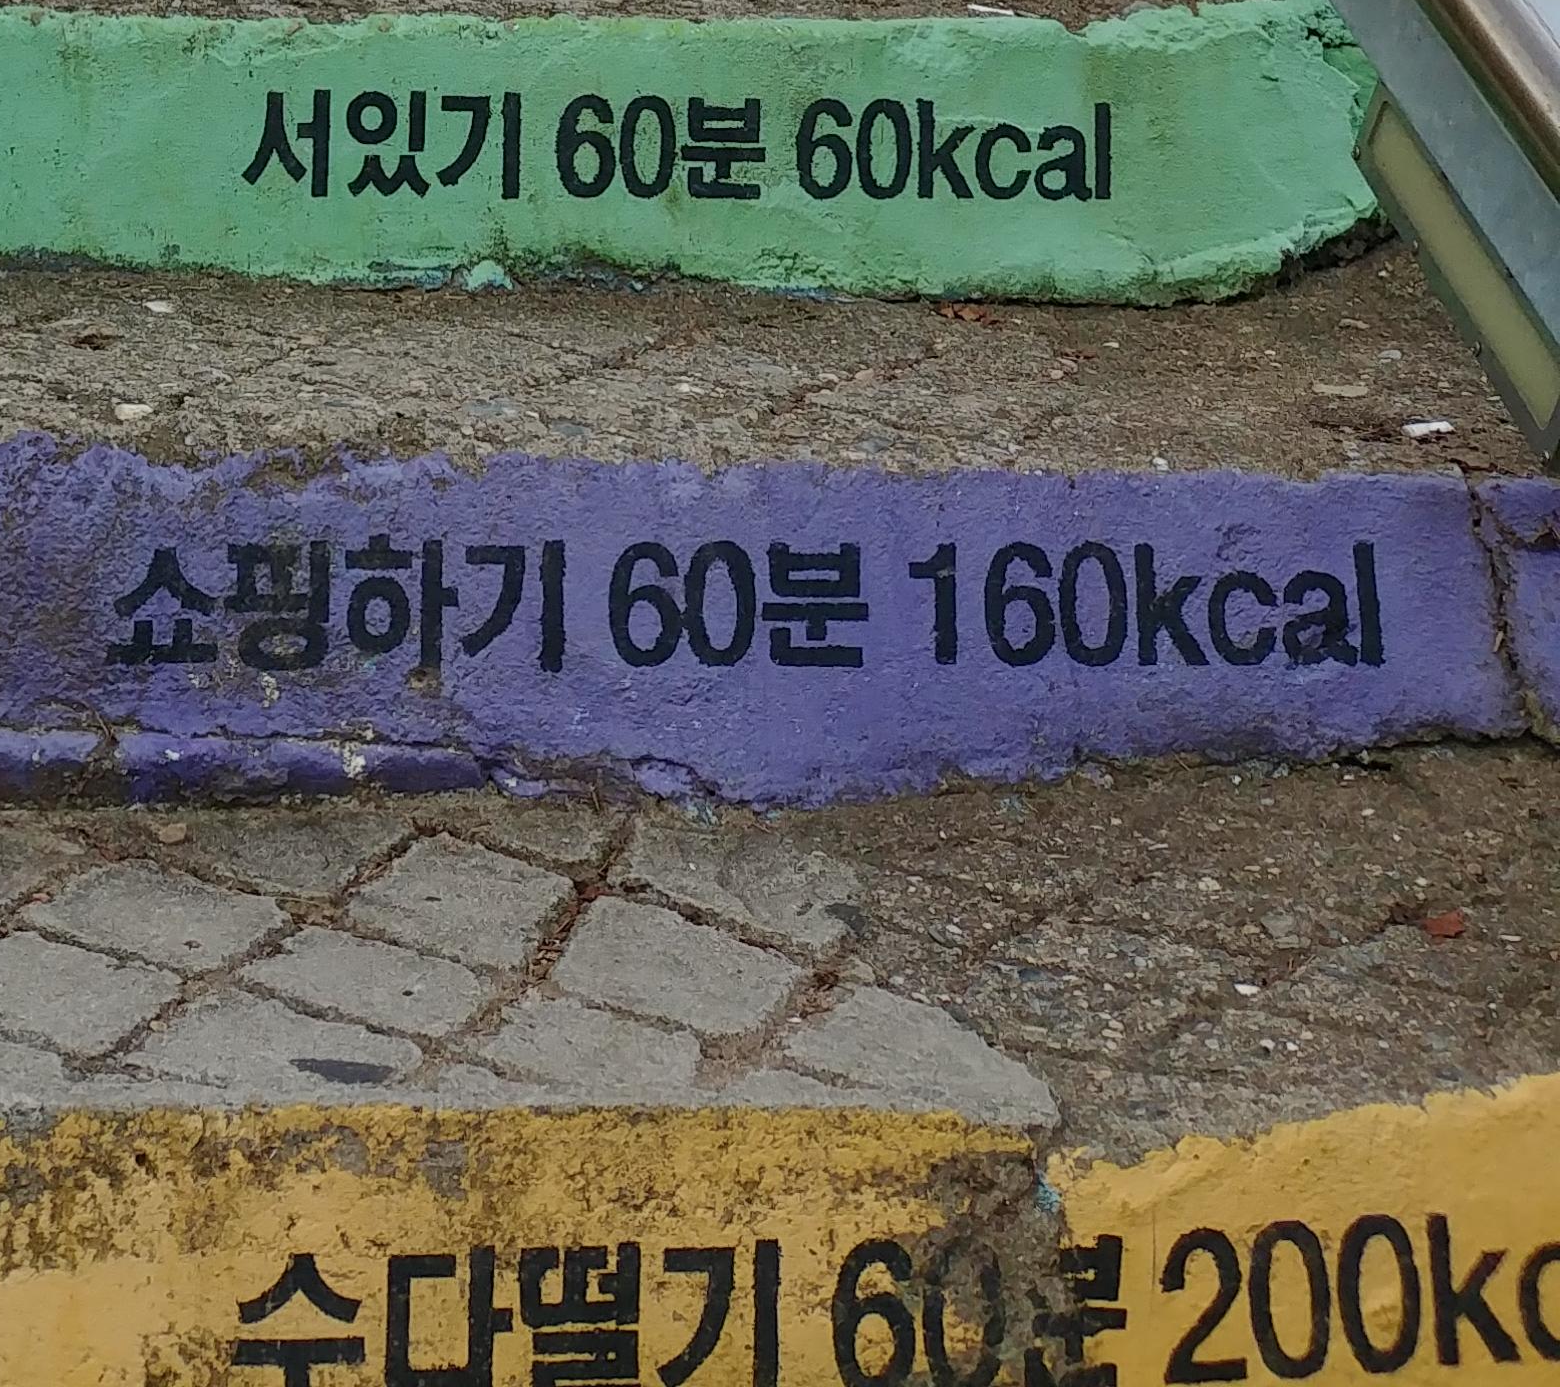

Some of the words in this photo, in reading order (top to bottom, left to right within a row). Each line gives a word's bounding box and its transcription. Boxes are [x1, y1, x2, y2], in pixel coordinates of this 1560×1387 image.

[241, 89, 522, 201] 서있기
[554, 93, 767, 201] 60분
[794, 97, 1113, 203] 60kcal
[106, 532, 566, 673] 쇼핑하기
[608, 540, 870, 669] 60분
[907, 540, 1386, 671] 160kcal
[230, 1238, 782, 1387] 수다떨기
[830, 1233, 1127, 1387] 60분
